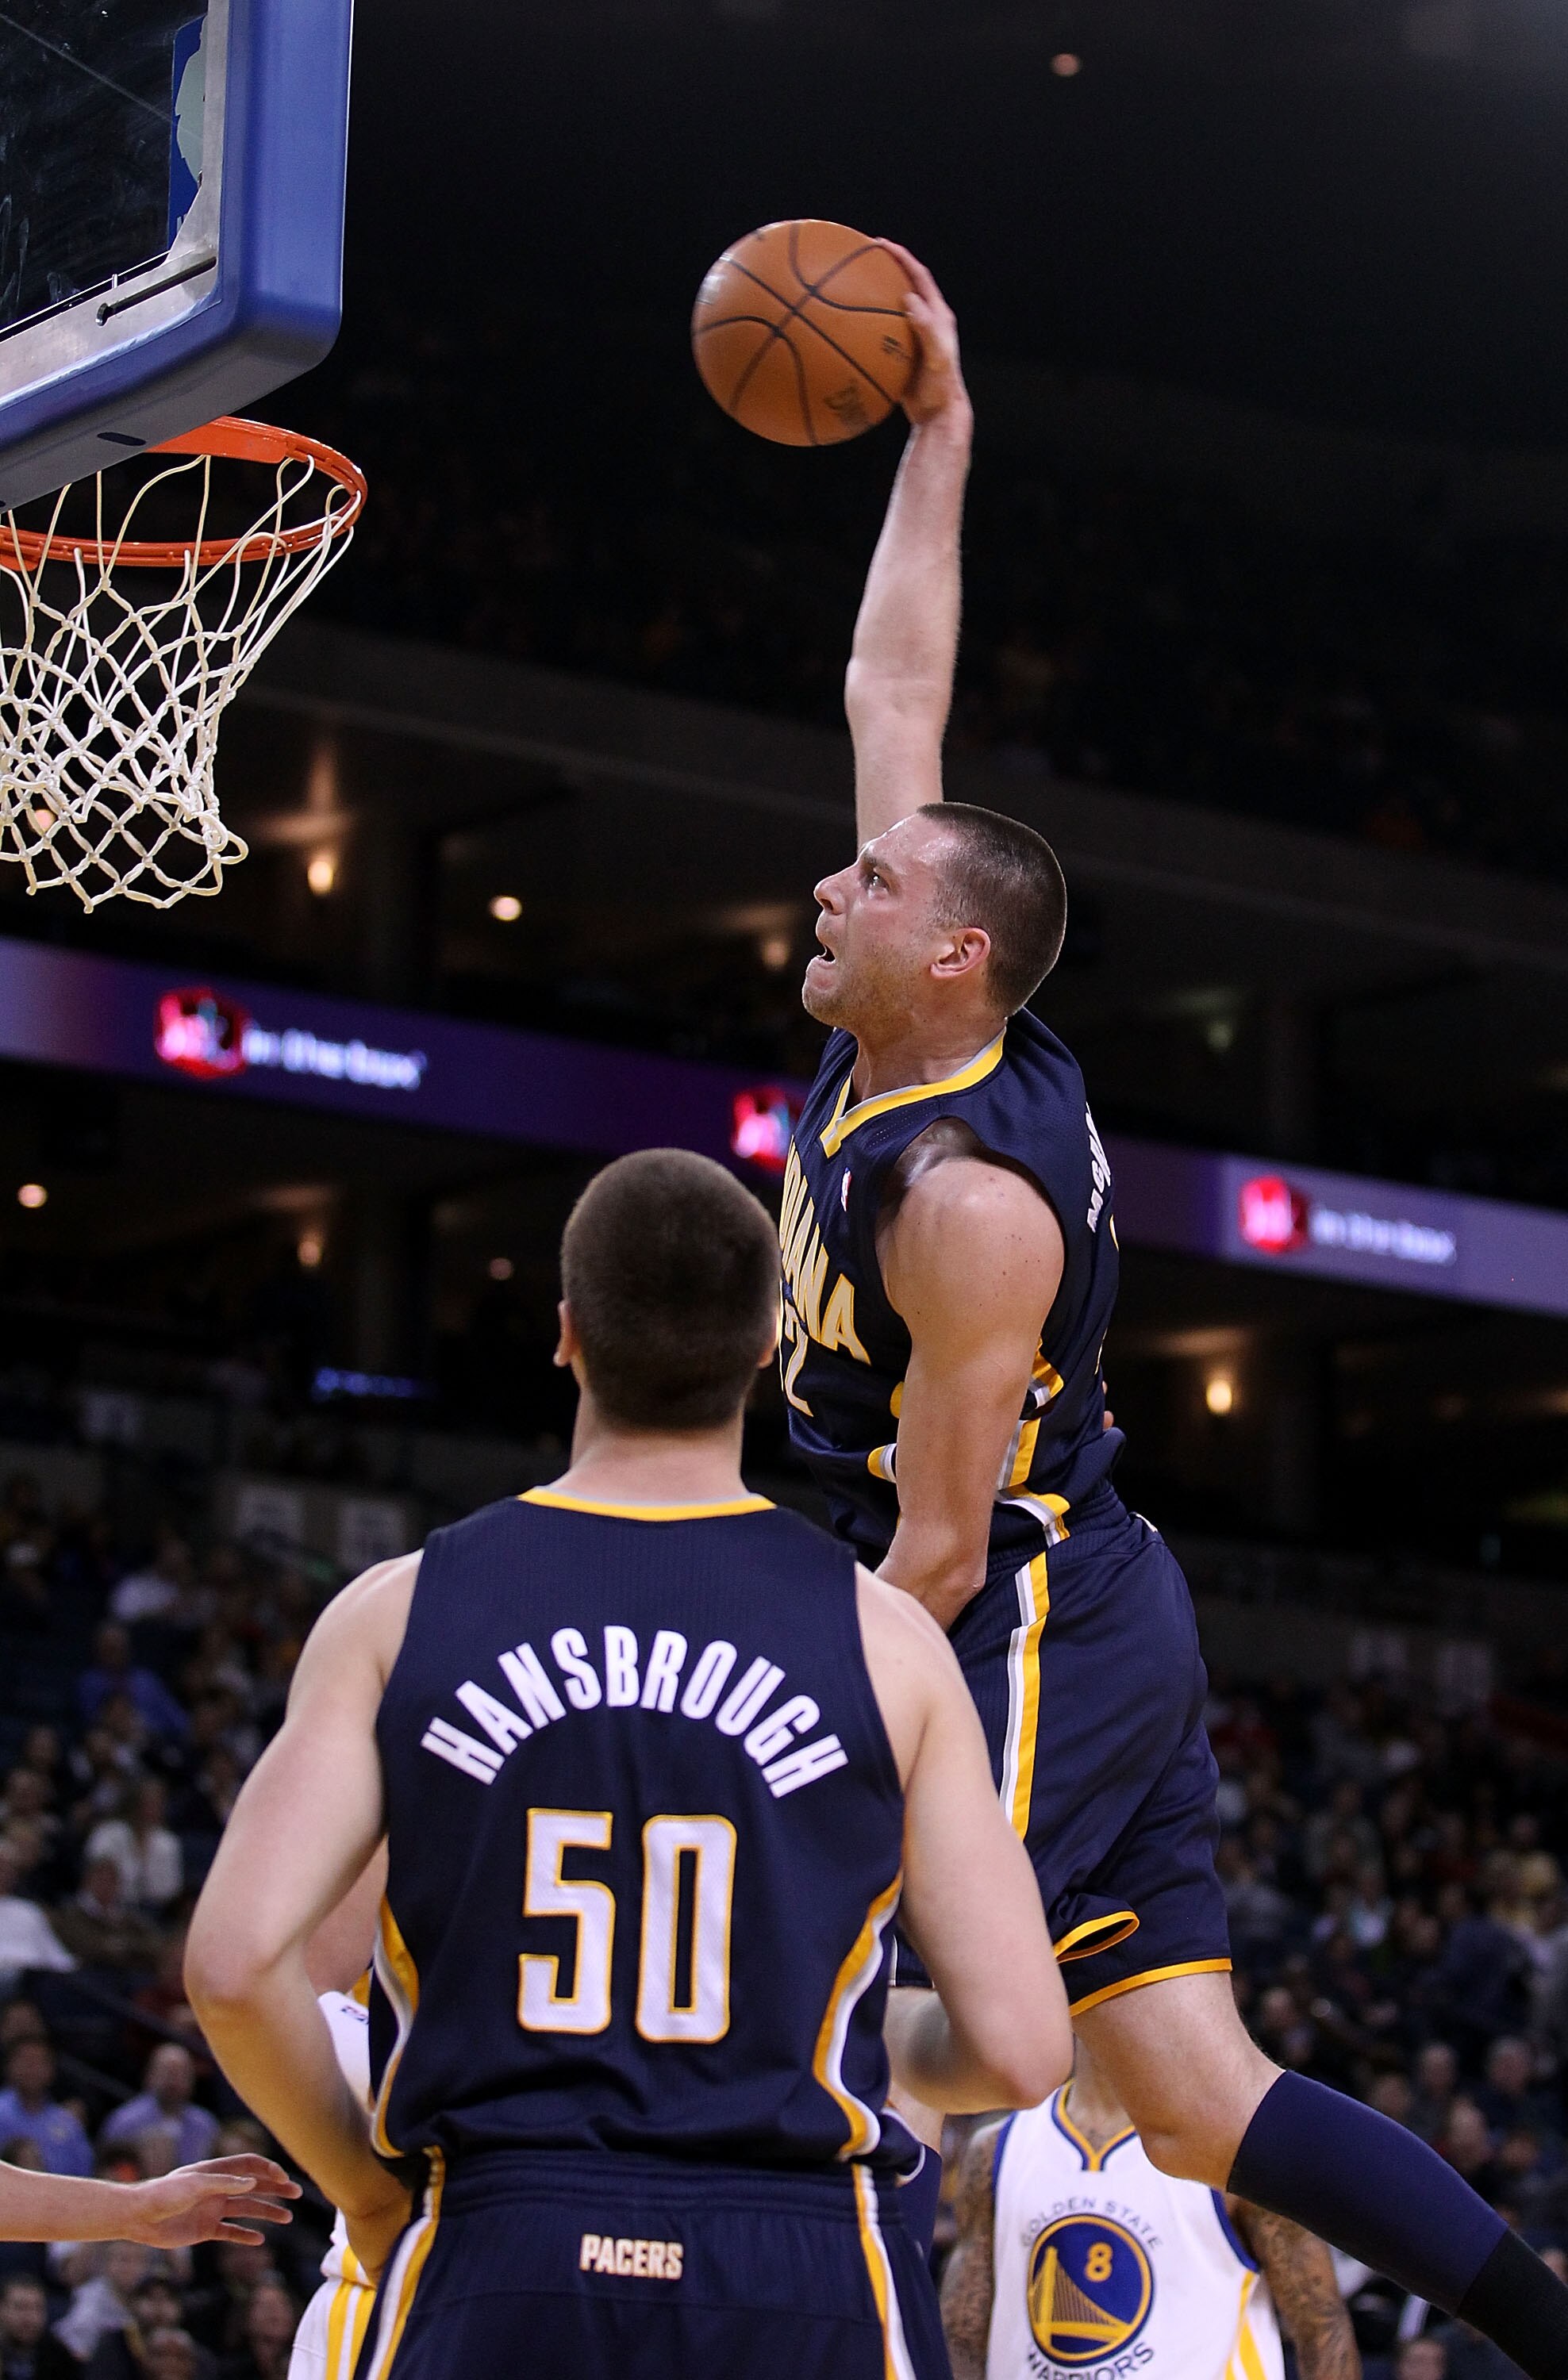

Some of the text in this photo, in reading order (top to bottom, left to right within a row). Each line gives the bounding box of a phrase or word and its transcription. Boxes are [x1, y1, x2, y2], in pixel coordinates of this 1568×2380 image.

[779, 1134, 871, 1366] DIANA
[421, 1625, 849, 1798] HANSBROUGH
[517, 1807, 737, 2044] 50
[579, 2233, 684, 2280] PACERS
[1020, 2196, 1163, 2249] GOLDEN STATE
[1085, 2242, 1113, 2282] 8
